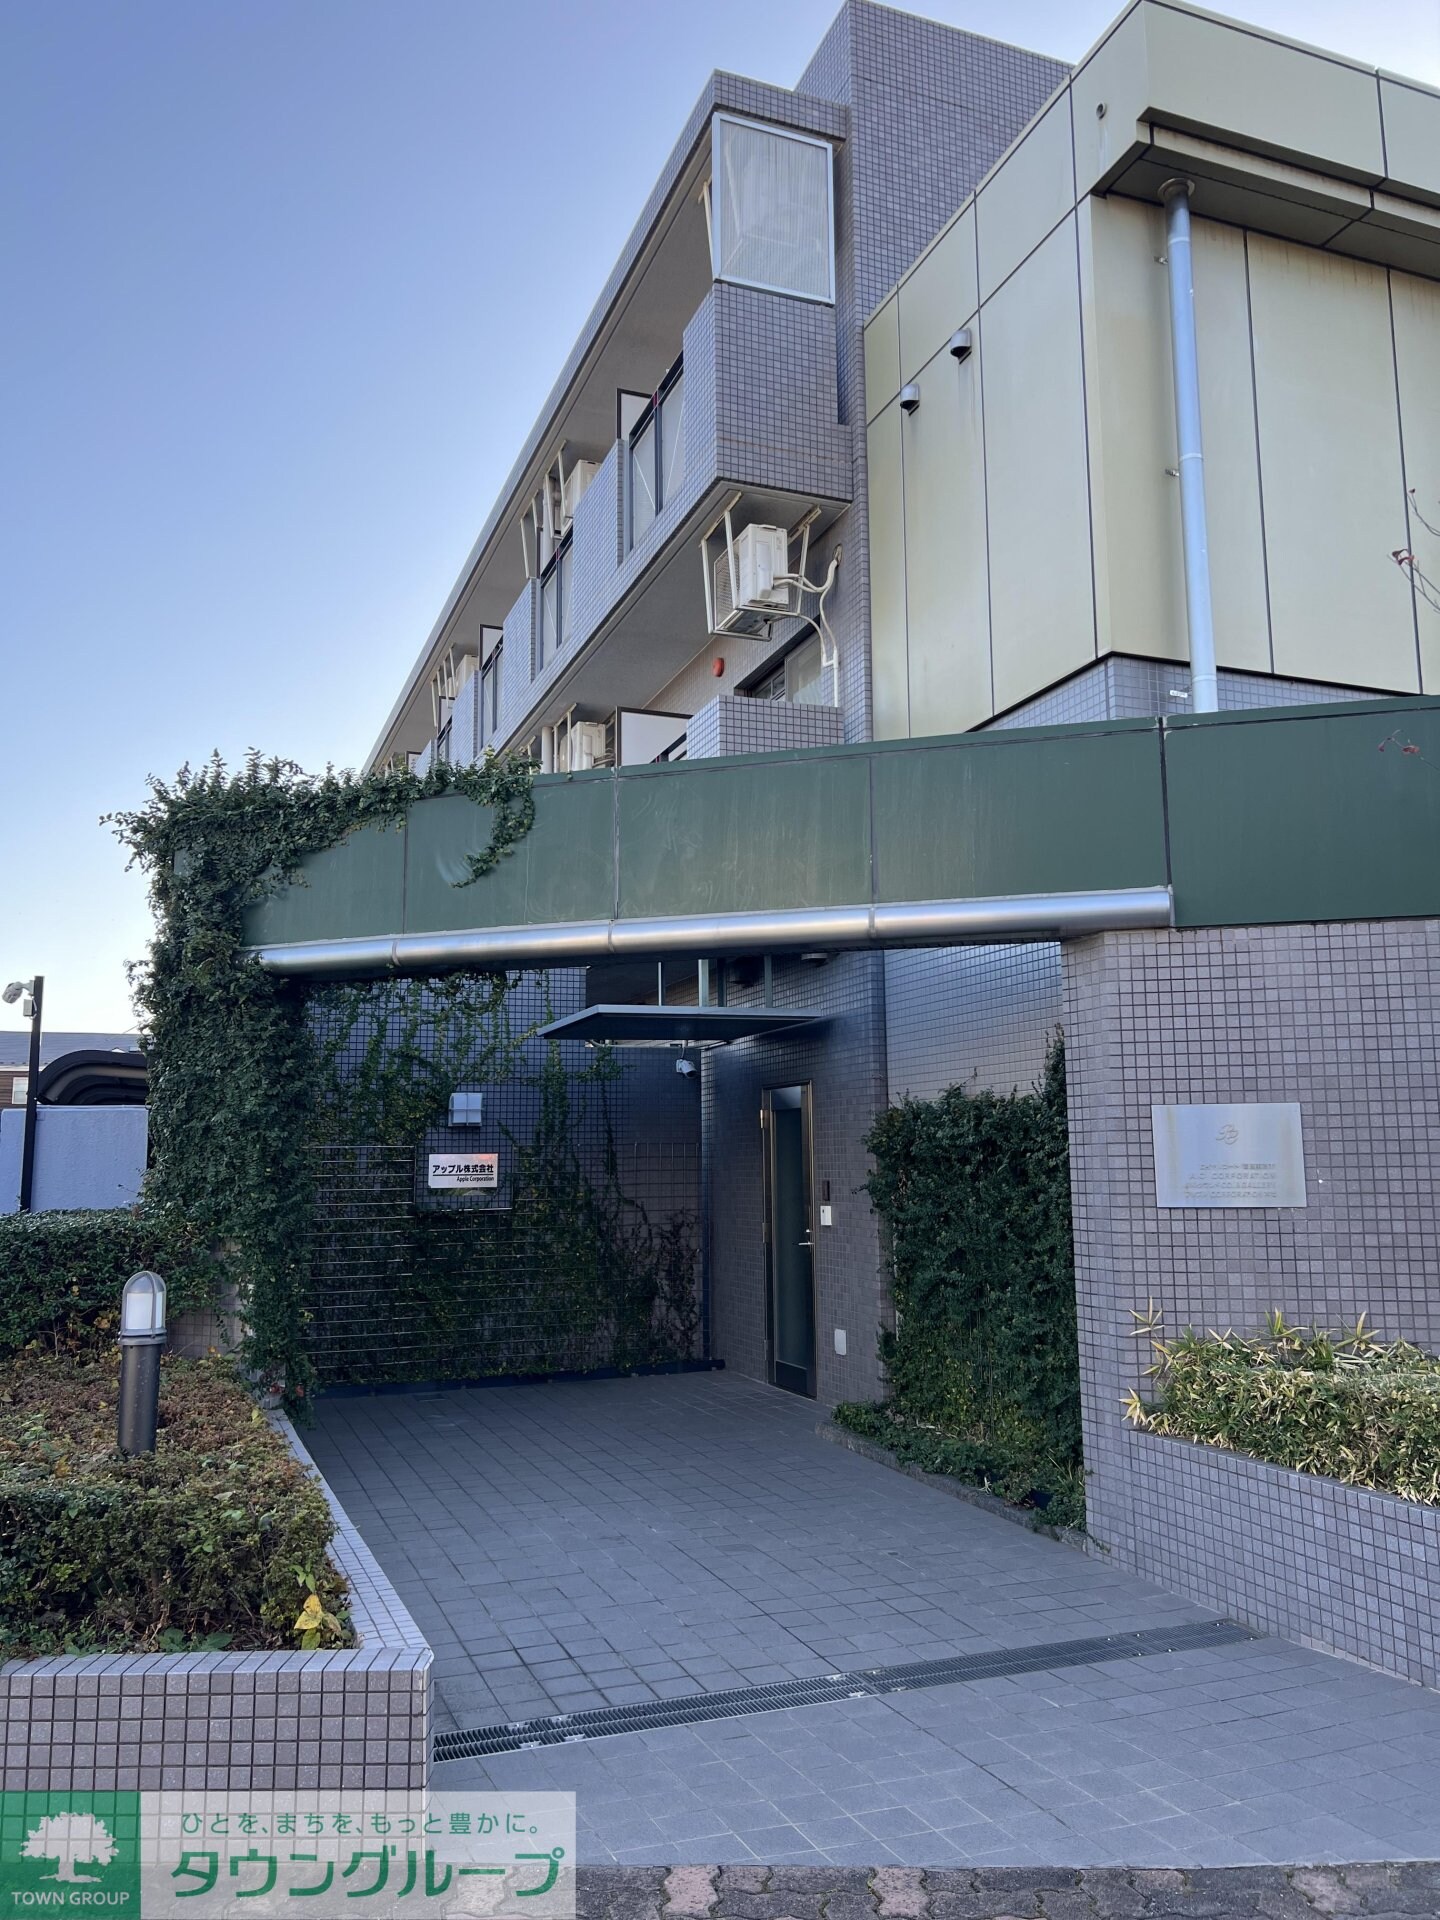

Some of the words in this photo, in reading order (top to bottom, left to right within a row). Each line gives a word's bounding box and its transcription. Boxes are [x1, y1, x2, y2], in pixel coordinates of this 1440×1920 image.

[432, 1164, 494, 1173] アップル株式会社
